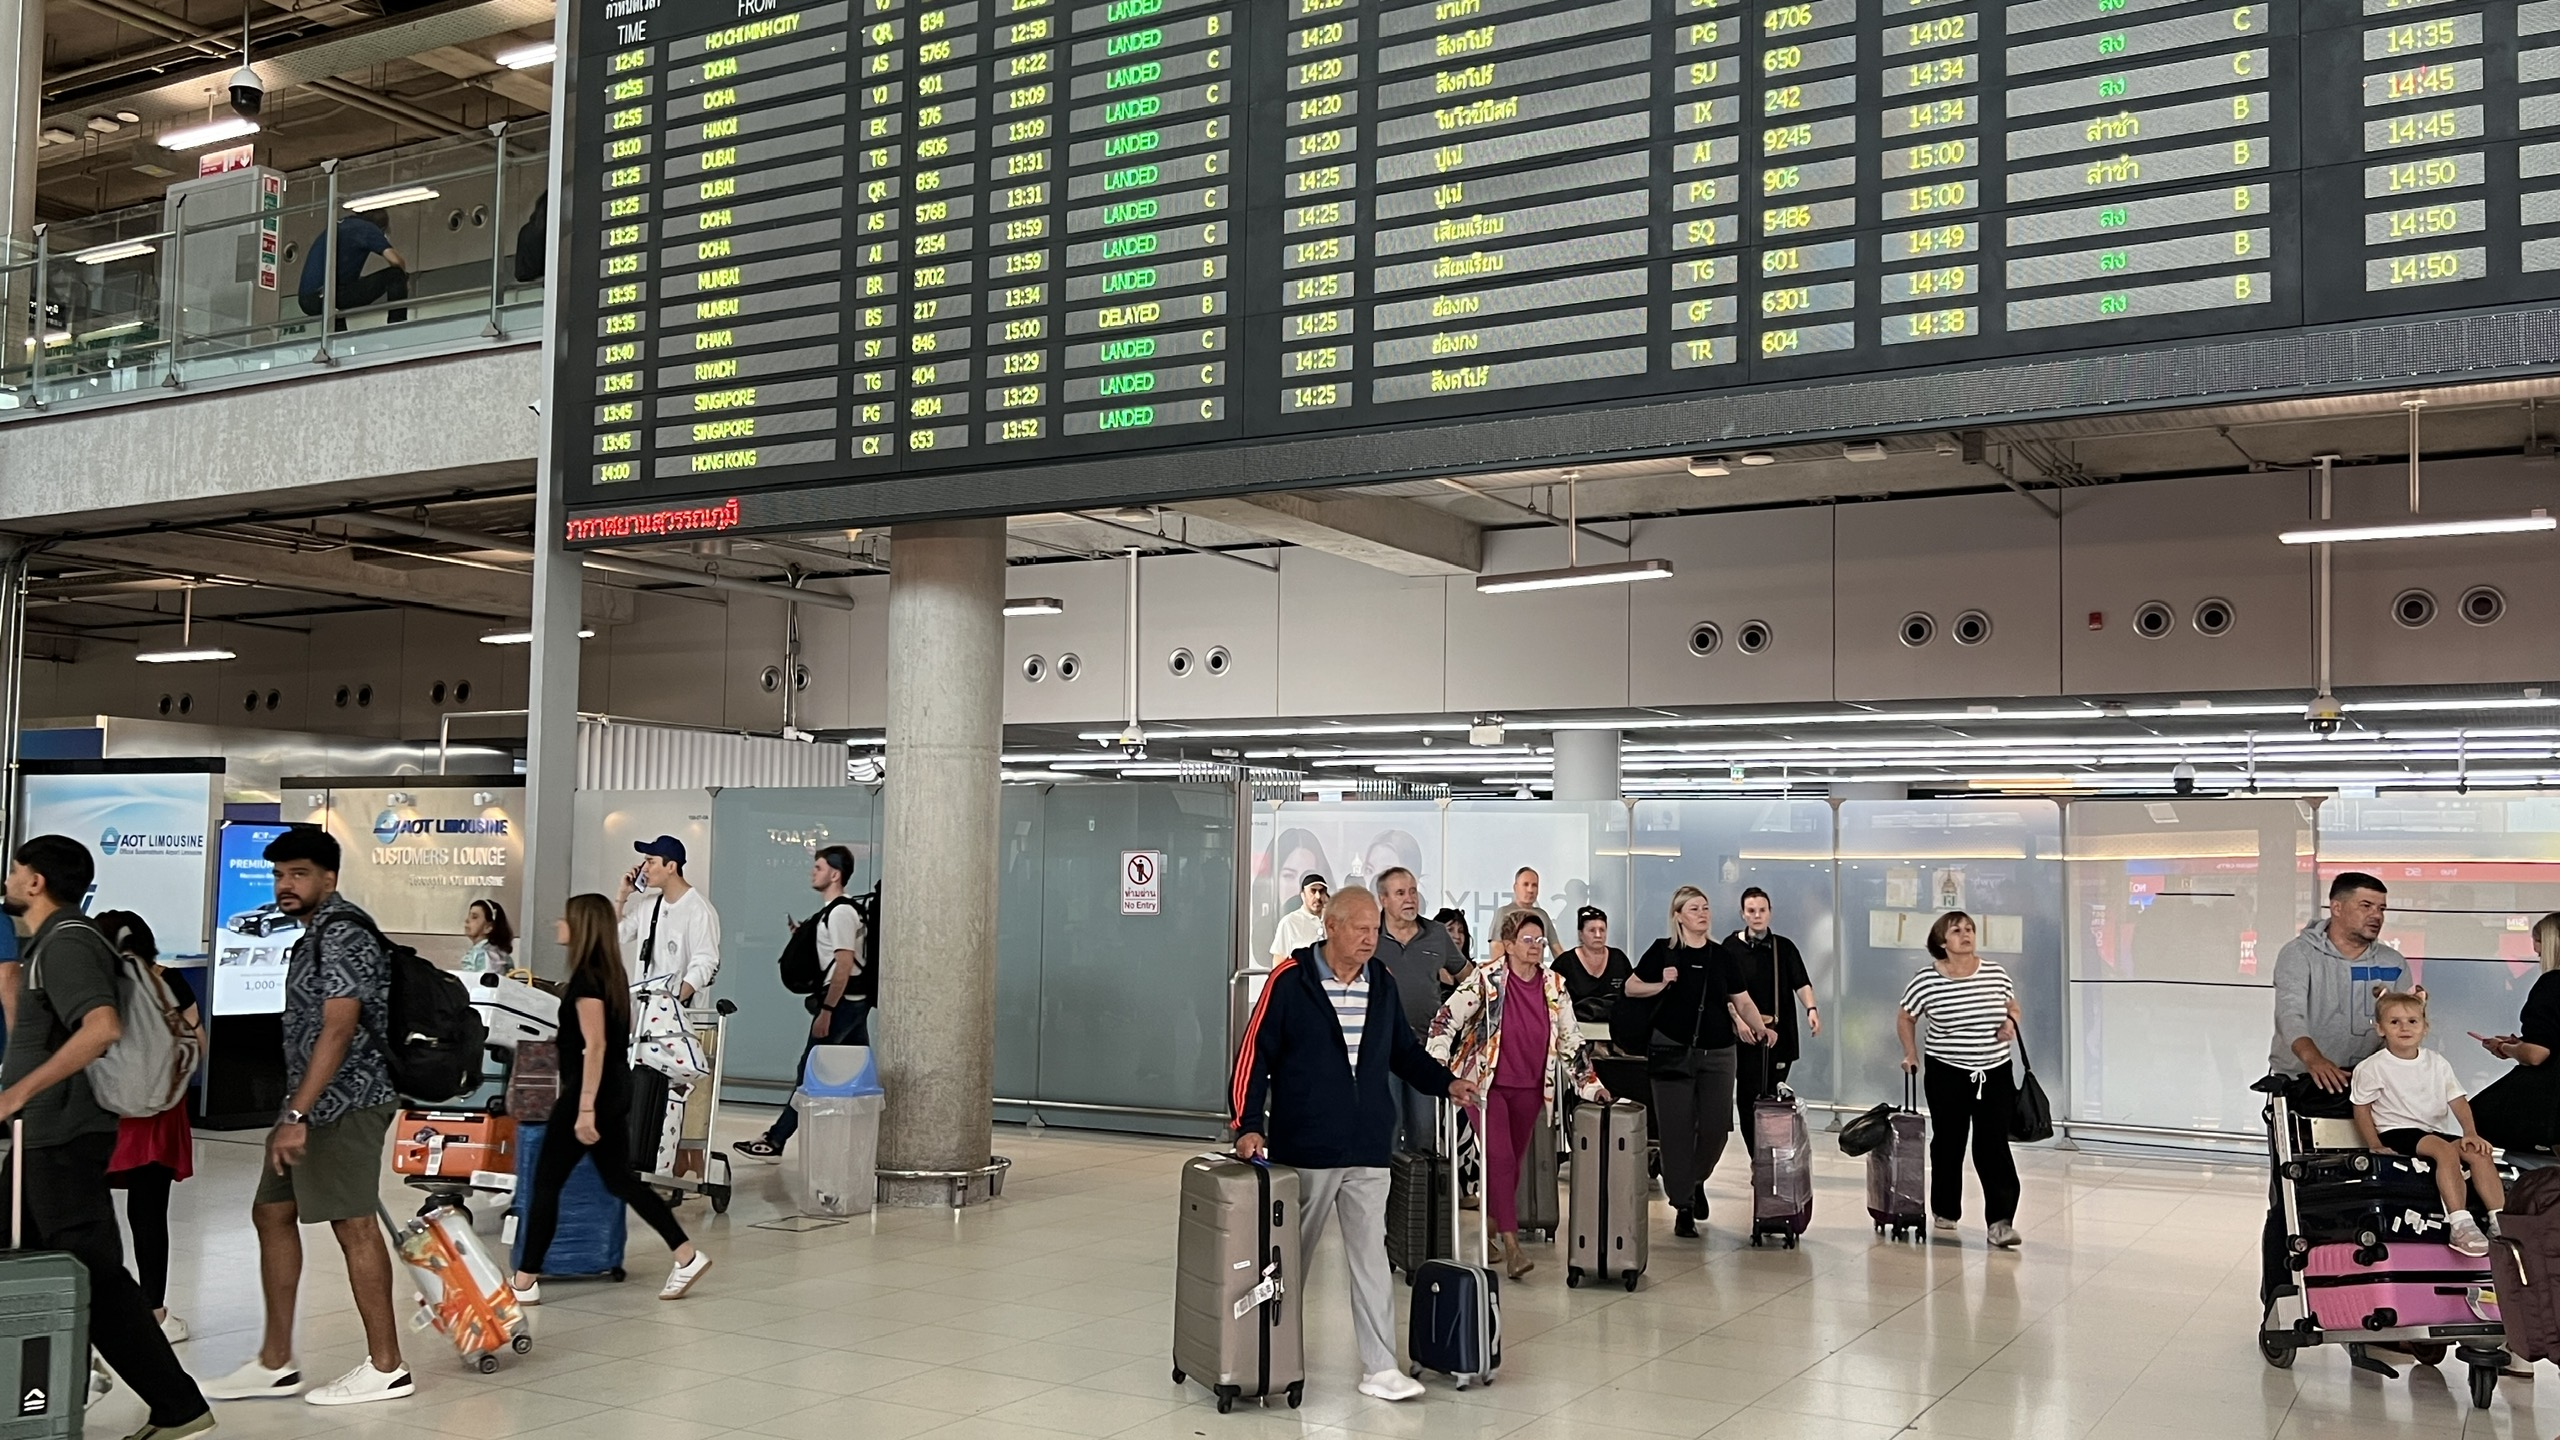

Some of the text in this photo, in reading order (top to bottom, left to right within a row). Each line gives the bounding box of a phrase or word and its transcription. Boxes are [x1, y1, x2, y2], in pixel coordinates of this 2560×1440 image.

[617, 20, 647, 45] TIME
[1763, 4, 1812, 31] 4706
[615, 13, 800, 71] 12:45 HO CHI MINH CITY
[1301, 23, 1343, 48] 14:20
[1763, 16, 1965, 71] 650 14:02
[2098, 34, 2127, 54] ลง
[2388, 20, 2455, 52] 14:35
[613, 0, 1164, 129] 12:55 DOHA 5766 12:58 LANDED
[613, 79, 643, 100] 12:55
[703, 57, 739, 80] DOHA
[1300, 59, 1343, 84] 14:20
[612, 28, 1164, 158] 13:00 HANOI 901 14:22 LANDED
[1765, 59, 1965, 111] 242 14:34
[2098, 77, 2127, 97] ลง
[2388, 65, 2456, 99] 14:45
[1300, 95, 1343, 119] 14:20
[612, 61, 1162, 187] 13:25 DUBAI 376 13:09 LANDED
[1763, 100, 1965, 151] 9245 14:34
[2085, 112, 2140, 141] ล่าช้า
[2389, 112, 2456, 144] 14:45
[610, 96, 1162, 216] 13:25 DUBAI 4506 13:09 LANDED
[1300, 131, 1342, 153] 14:20
[1299, 168, 1341, 191] 14:25
[1763, 141, 1966, 192] 906 15:00
[2085, 155, 2140, 184] ล่าช้า
[2390, 160, 2457, 191] 14:50
[609, 225, 639, 245] 13:25
[699, 209, 732, 229] DOHA
[1008, 152, 1043, 174] 13:31
[1104, 131, 1161, 157] LANDED
[608, 255, 637, 274] 13:25
[697, 239, 730, 259] DOHA
[1008, 186, 1042, 207] 13:31
[1103, 165, 1160, 192] LANDED
[1298, 204, 1340, 227] 14:25
[1763, 182, 1965, 232] 5486 15:00
[2098, 208, 2128, 227] ลง
[2390, 206, 2458, 237] 14:50
[607, 199, 1159, 304] 13:35 MUMBAI 2354 13:59 LANDED
[1297, 238, 1339, 262] 14:25
[1762, 225, 1966, 271] 601 14:49
[2099, 252, 2128, 270] ลง
[607, 234, 1159, 333] 13:35 MUMBAI 3702 13:59 LANDED
[2391, 253, 2459, 283] 14:50
[1297, 275, 1338, 299] 14:25
[1762, 267, 1966, 313] 6301 14:49
[605, 268, 1158, 363] 13:40 DHAKA 217 13:34 LANDED
[2099, 294, 2128, 314] ลง
[1297, 312, 1339, 334] 14:25
[1761, 309, 1966, 353] 604 14:38
[604, 373, 634, 392] 13:45
[694, 360, 738, 380] RIYADH
[1006, 319, 1040, 340] 15:00
[1098, 302, 1160, 329] DELAYED
[1296, 348, 1336, 370] 14:25
[603, 337, 1157, 422] 13:45 SINGAPORE 404 13:29 LANDED
[1296, 385, 1336, 406] 14:25
[602, 433, 632, 452] 13:45
[692, 418, 754, 441] SINGAPORE
[1004, 385, 1040, 407] 13:29
[1099, 372, 1156, 396] LANDED
[601, 406, 1155, 480] 14:00 HONG KONG 653 13:52 LANDED
[119, 834, 203, 848] AOT LIMOUSINE
[399, 819, 508, 836] AOT LIMOUSINE
[371, 846, 506, 866] CUSTOMERS LOUNGE
[1125, 887, 1156, 897] ห้ามผ่าน
[1136, 901, 1156, 910] Entry
[245, 981, 275, 991] 1,000
